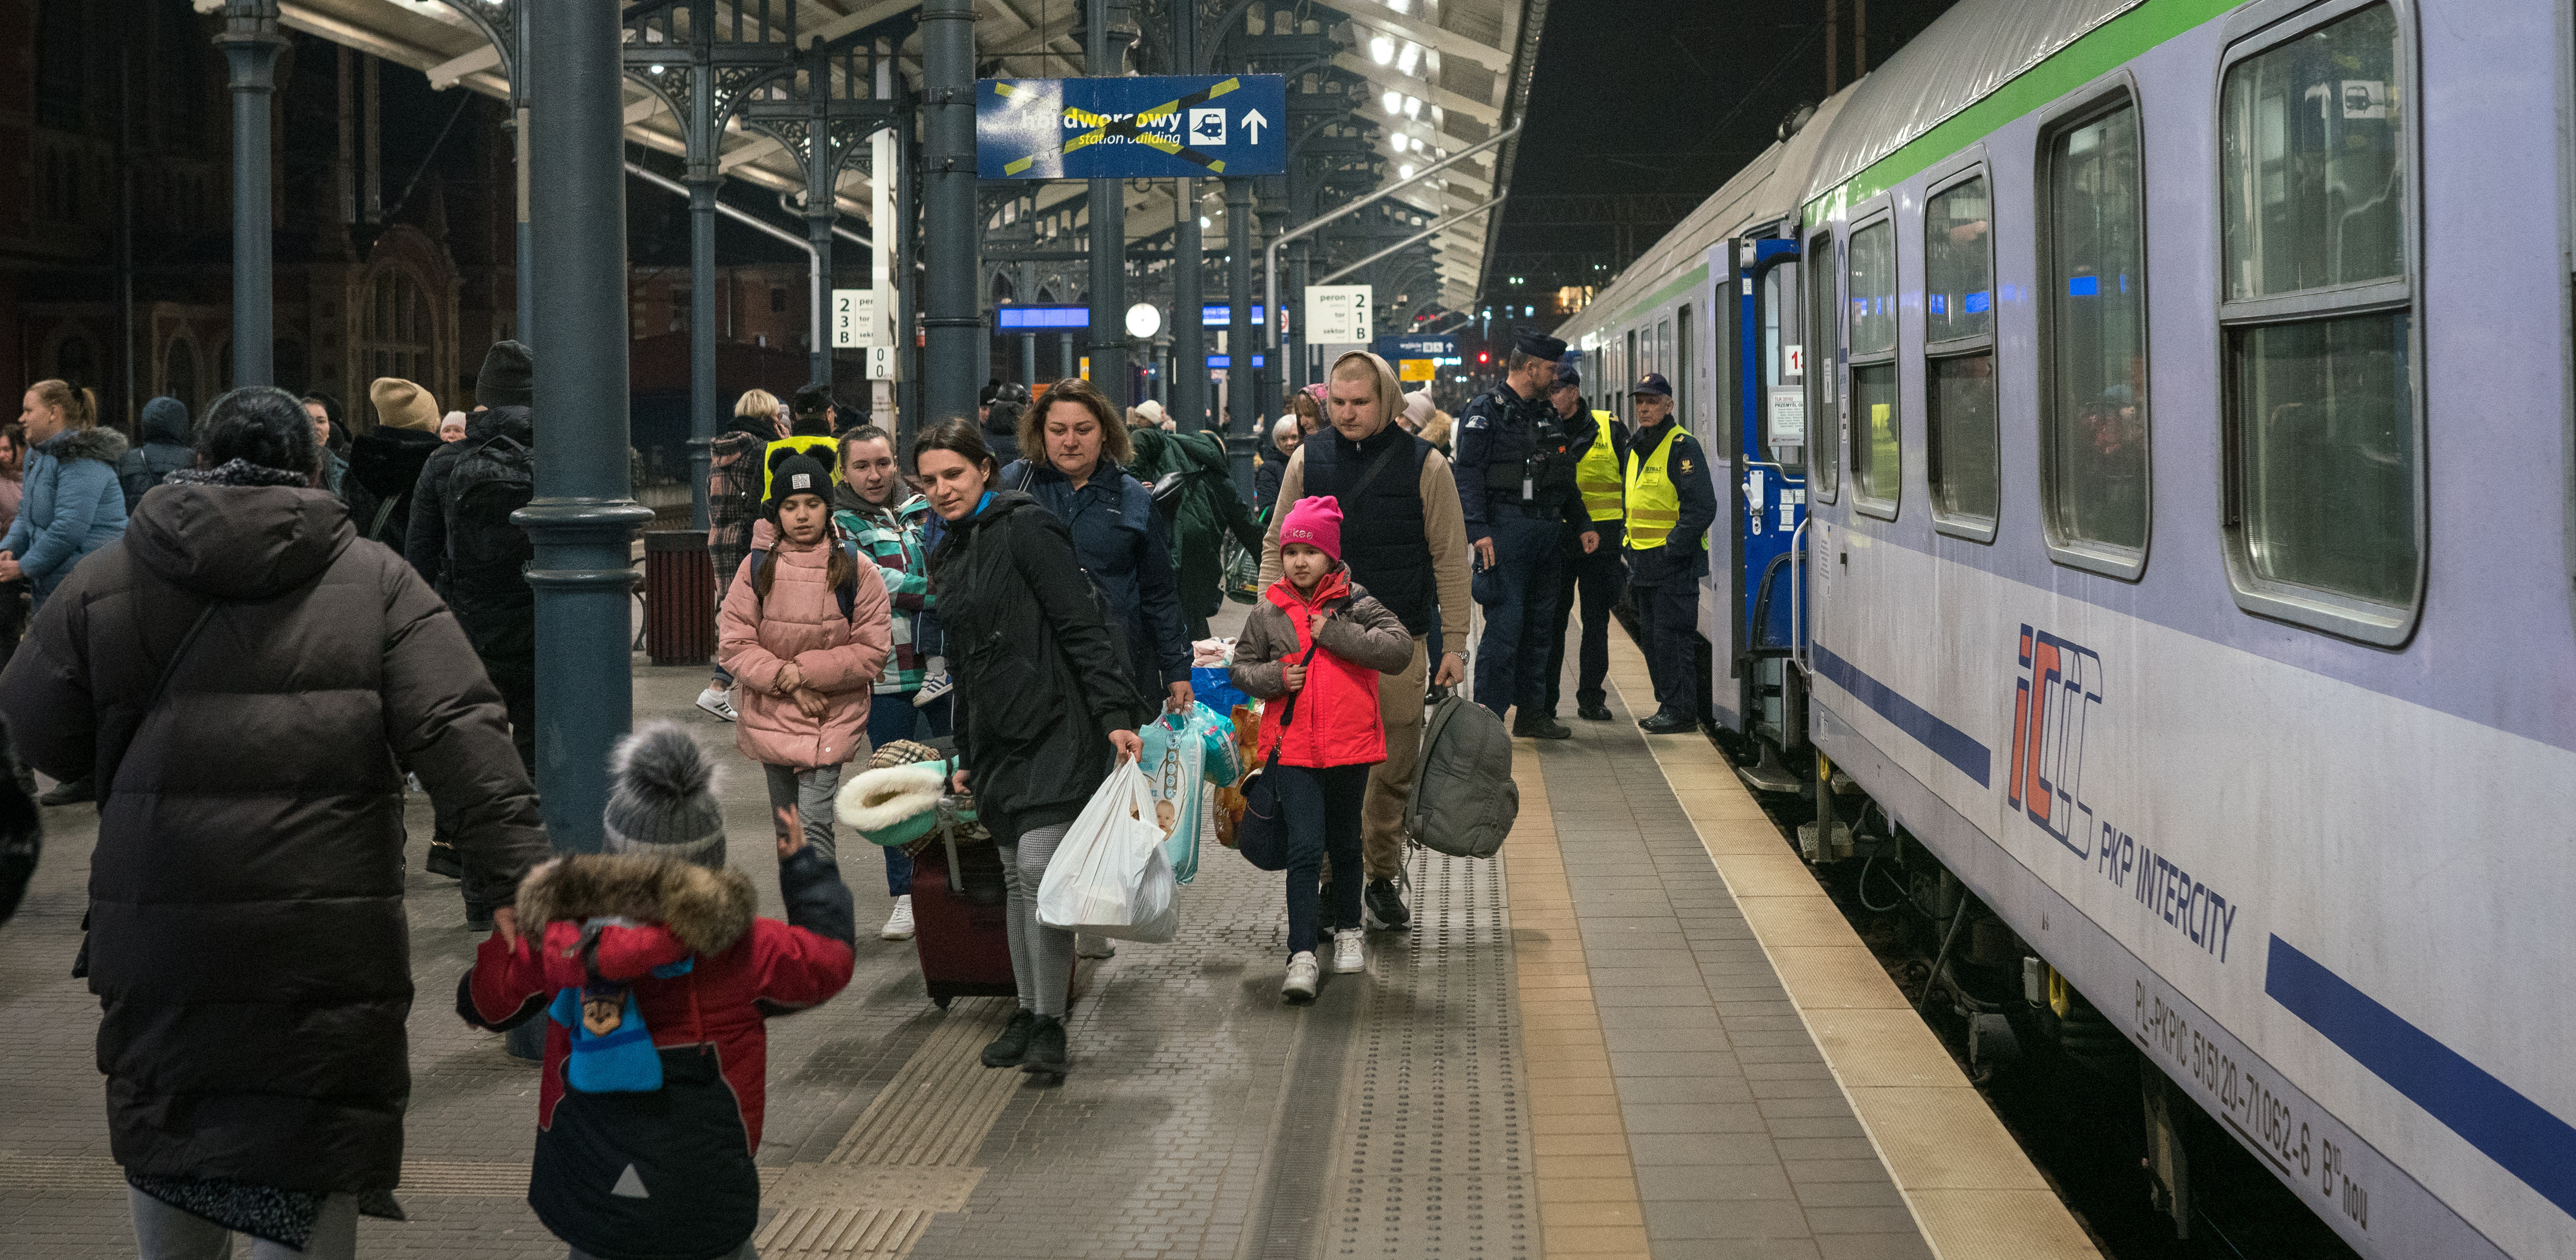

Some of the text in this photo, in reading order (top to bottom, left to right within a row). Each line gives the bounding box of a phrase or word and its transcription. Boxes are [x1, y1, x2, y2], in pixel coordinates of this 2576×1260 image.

[1079, 133, 1124, 144] station
[840, 298, 850, 312] 2
[1356, 294, 1365, 307] 2
[841, 315, 849, 328] 3
[1357, 312, 1362, 323] 1
[840, 331, 849, 343] B
[1357, 328, 1365, 339] B
[877, 348, 884, 361] 0
[876, 365, 883, 378] 0
[2098, 821, 2237, 964] PKP INTERCITY
[2135, 979, 2188, 1067] PL-PKPIC
